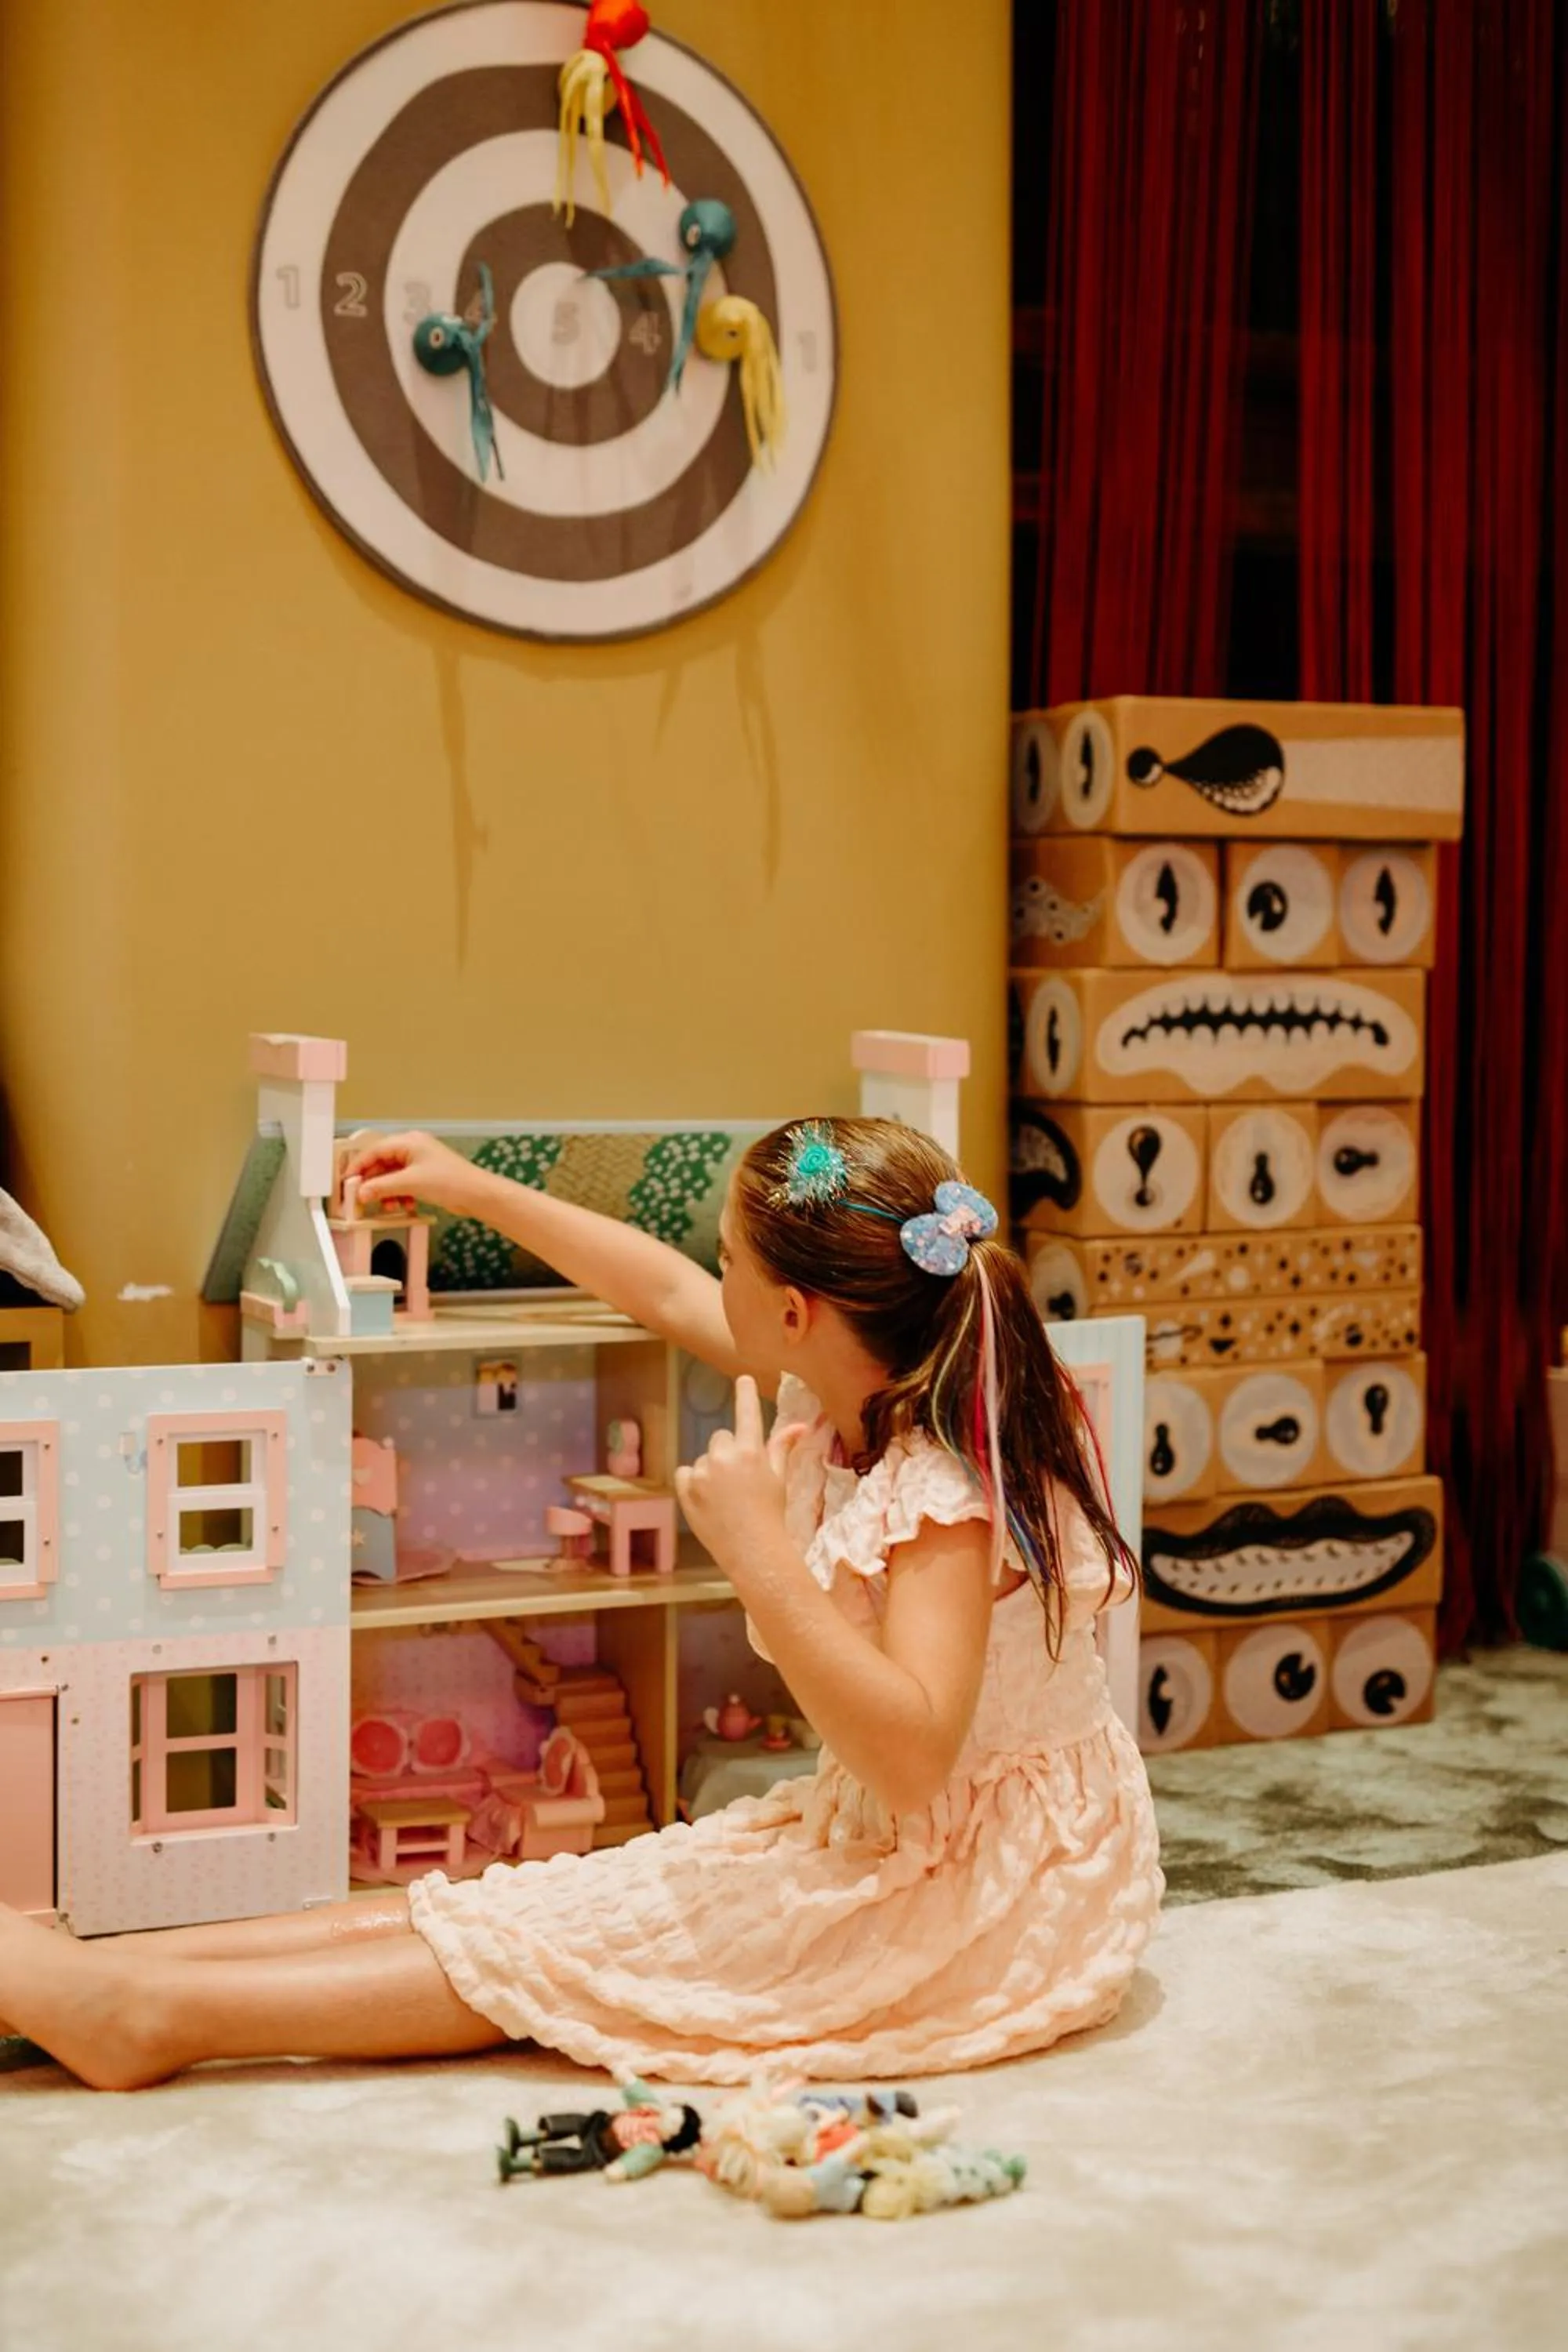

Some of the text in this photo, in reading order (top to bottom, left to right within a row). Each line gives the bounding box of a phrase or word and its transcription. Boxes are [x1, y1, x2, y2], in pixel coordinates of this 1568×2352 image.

[275, 265, 300, 310] 1
[334, 271, 368, 317] 2
[629, 311, 662, 355] 4
